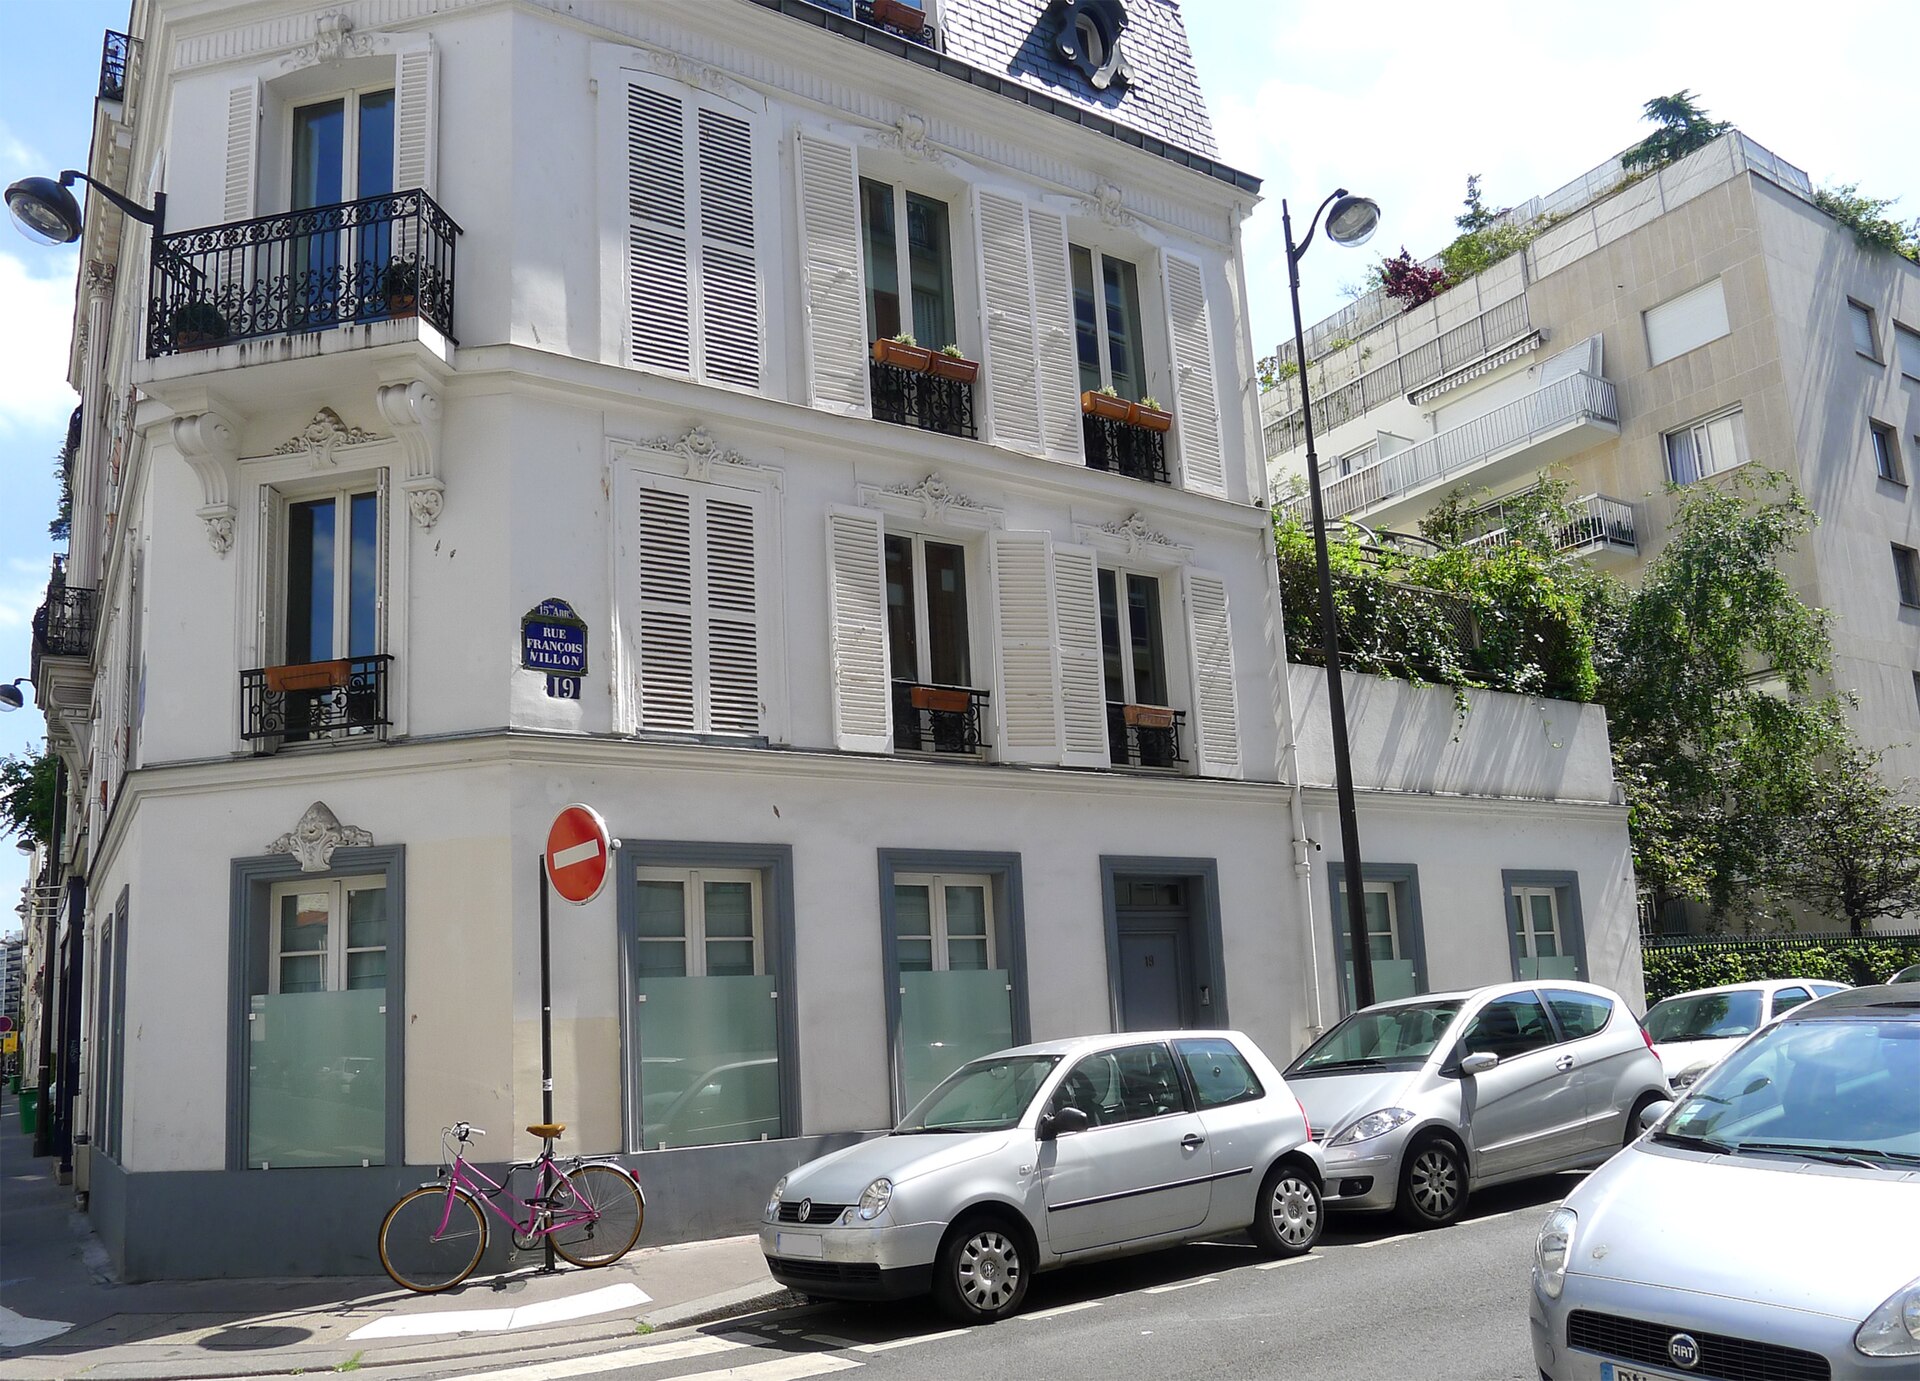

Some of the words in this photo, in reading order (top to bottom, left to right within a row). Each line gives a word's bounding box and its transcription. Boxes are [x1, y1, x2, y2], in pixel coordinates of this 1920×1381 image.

[543, 627, 566, 639] RUE
[526, 638, 583, 654] FRANÇOIS
[529, 650, 580, 666] VILLON
[553, 677, 575, 699] 19
[1672, 1343, 1694, 1359] FIAT
